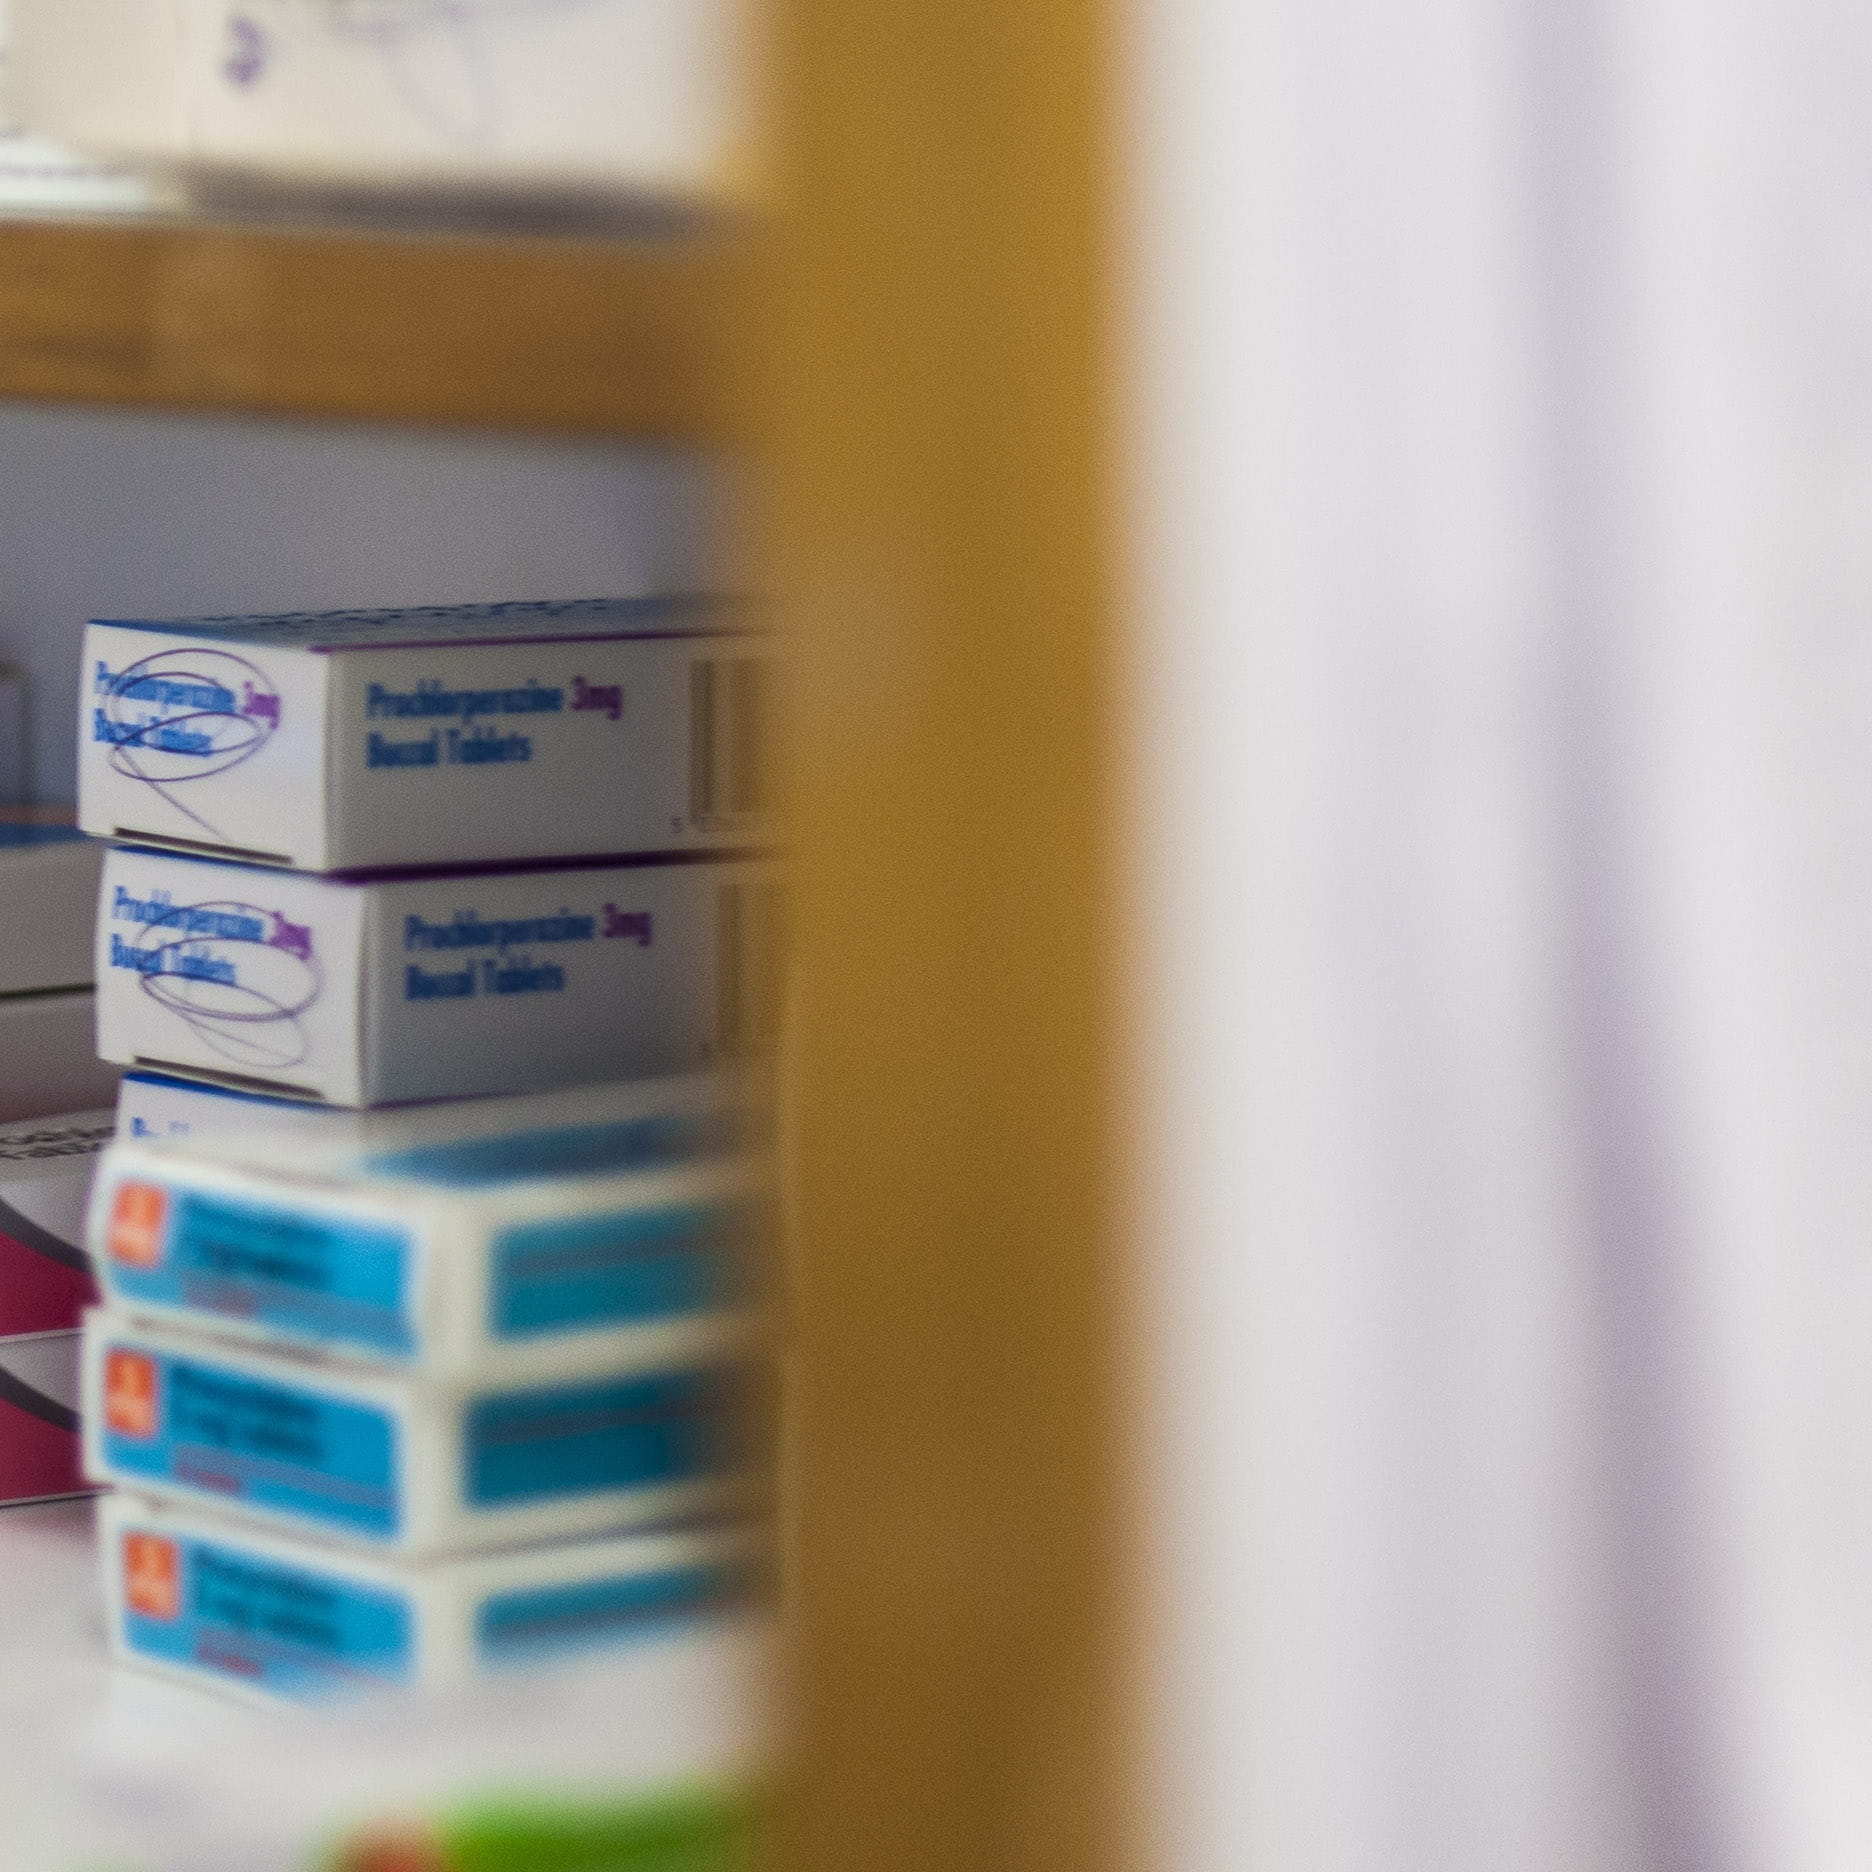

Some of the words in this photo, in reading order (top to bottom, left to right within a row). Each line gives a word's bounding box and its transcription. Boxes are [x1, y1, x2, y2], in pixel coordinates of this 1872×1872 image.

[241, 679, 281, 732] 3mg
[366, 676, 565, 726] Prochlorperazine
[570, 674, 624, 722] 3mg
[366, 728, 440, 770] Buccal
[448, 725, 533, 766] Tablets
[111, 884, 266, 943] Prochlorperazine
[269, 909, 313, 964] 3mg
[403, 906, 596, 957] Prochlorperazine
[601, 901, 653, 949] 3mg
[403, 958, 476, 1001] Buccal
[483, 954, 566, 997] Tablets
